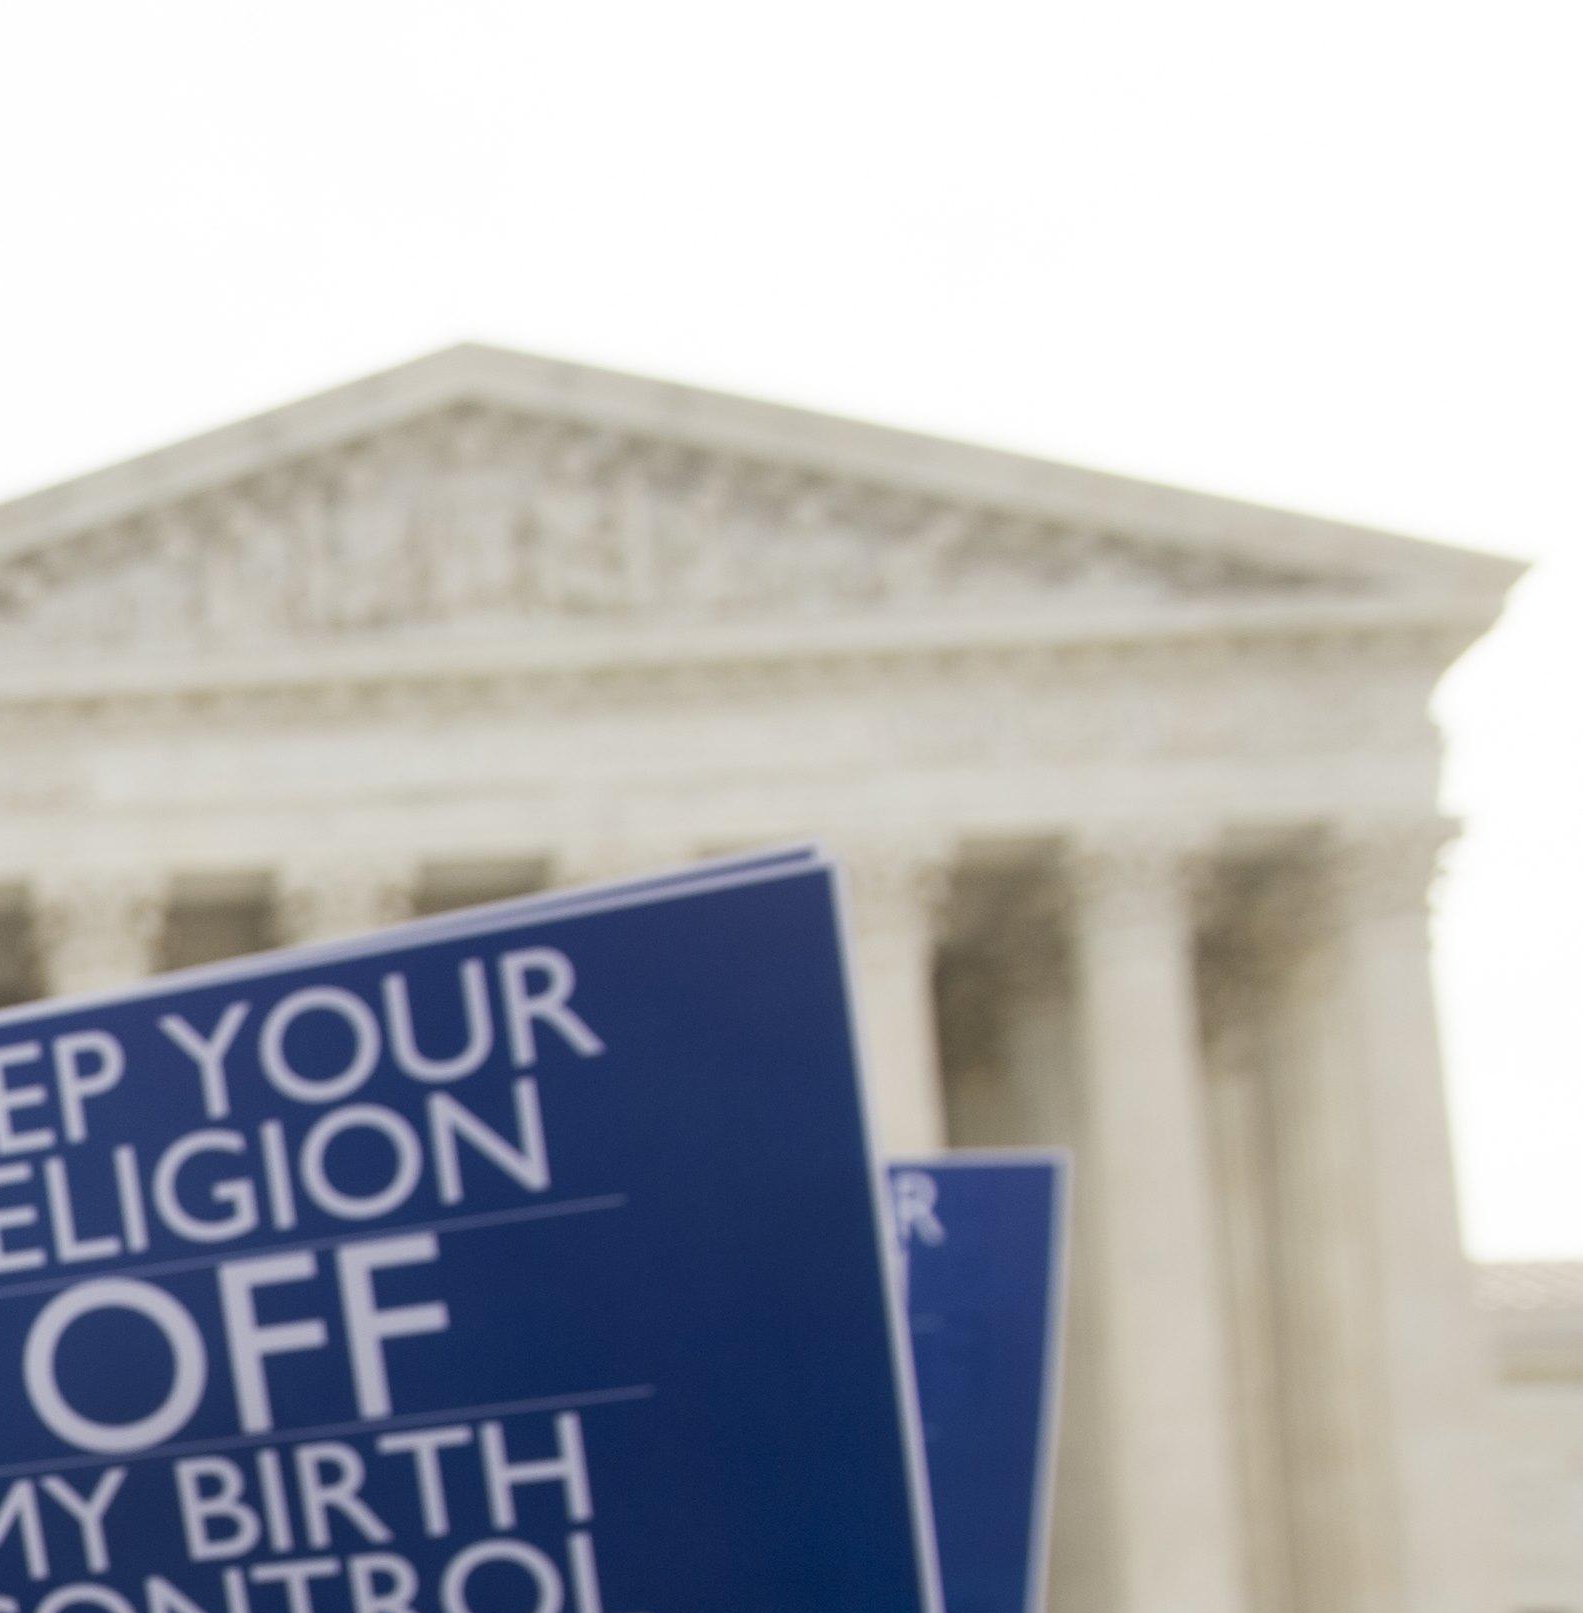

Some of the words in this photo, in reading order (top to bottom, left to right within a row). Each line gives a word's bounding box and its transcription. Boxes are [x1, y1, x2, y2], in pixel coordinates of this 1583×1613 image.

[157, 945, 606, 1122] YOUR
[21, 1231, 450, 1456] OFF
[174, 1410, 594, 1563] BIRTH
